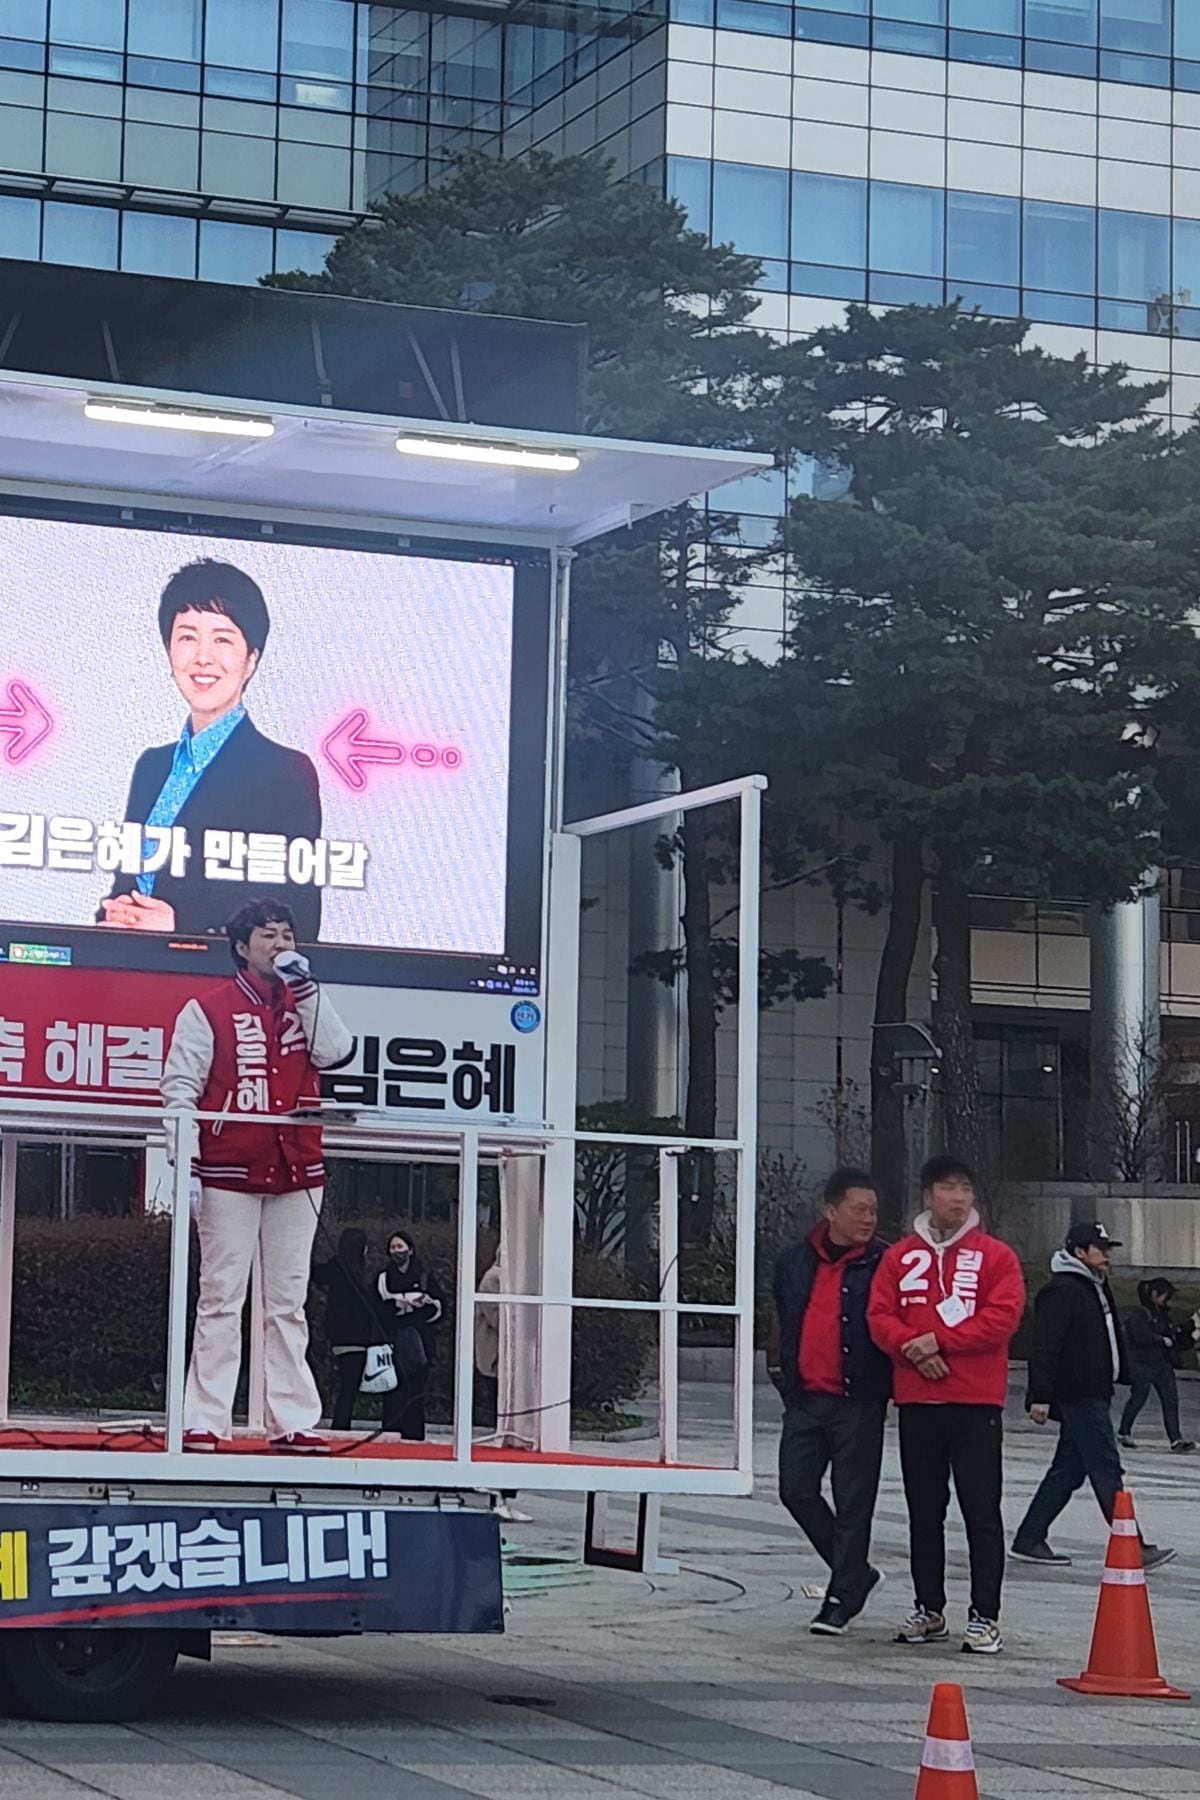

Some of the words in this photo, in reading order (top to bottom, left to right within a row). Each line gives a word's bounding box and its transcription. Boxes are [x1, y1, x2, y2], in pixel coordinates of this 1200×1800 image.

[203, 828, 369, 889] 만들어갈
[45, 1020, 165, 1090] 해결
[232, 1012, 270, 1112] 김은혜
[280, 1010, 306, 1045] 2
[317, 1036, 516, 1114] 김은혜
[899, 1249, 932, 1292] 2
[48, 1510, 389, 1598] 갚겠습니다!
